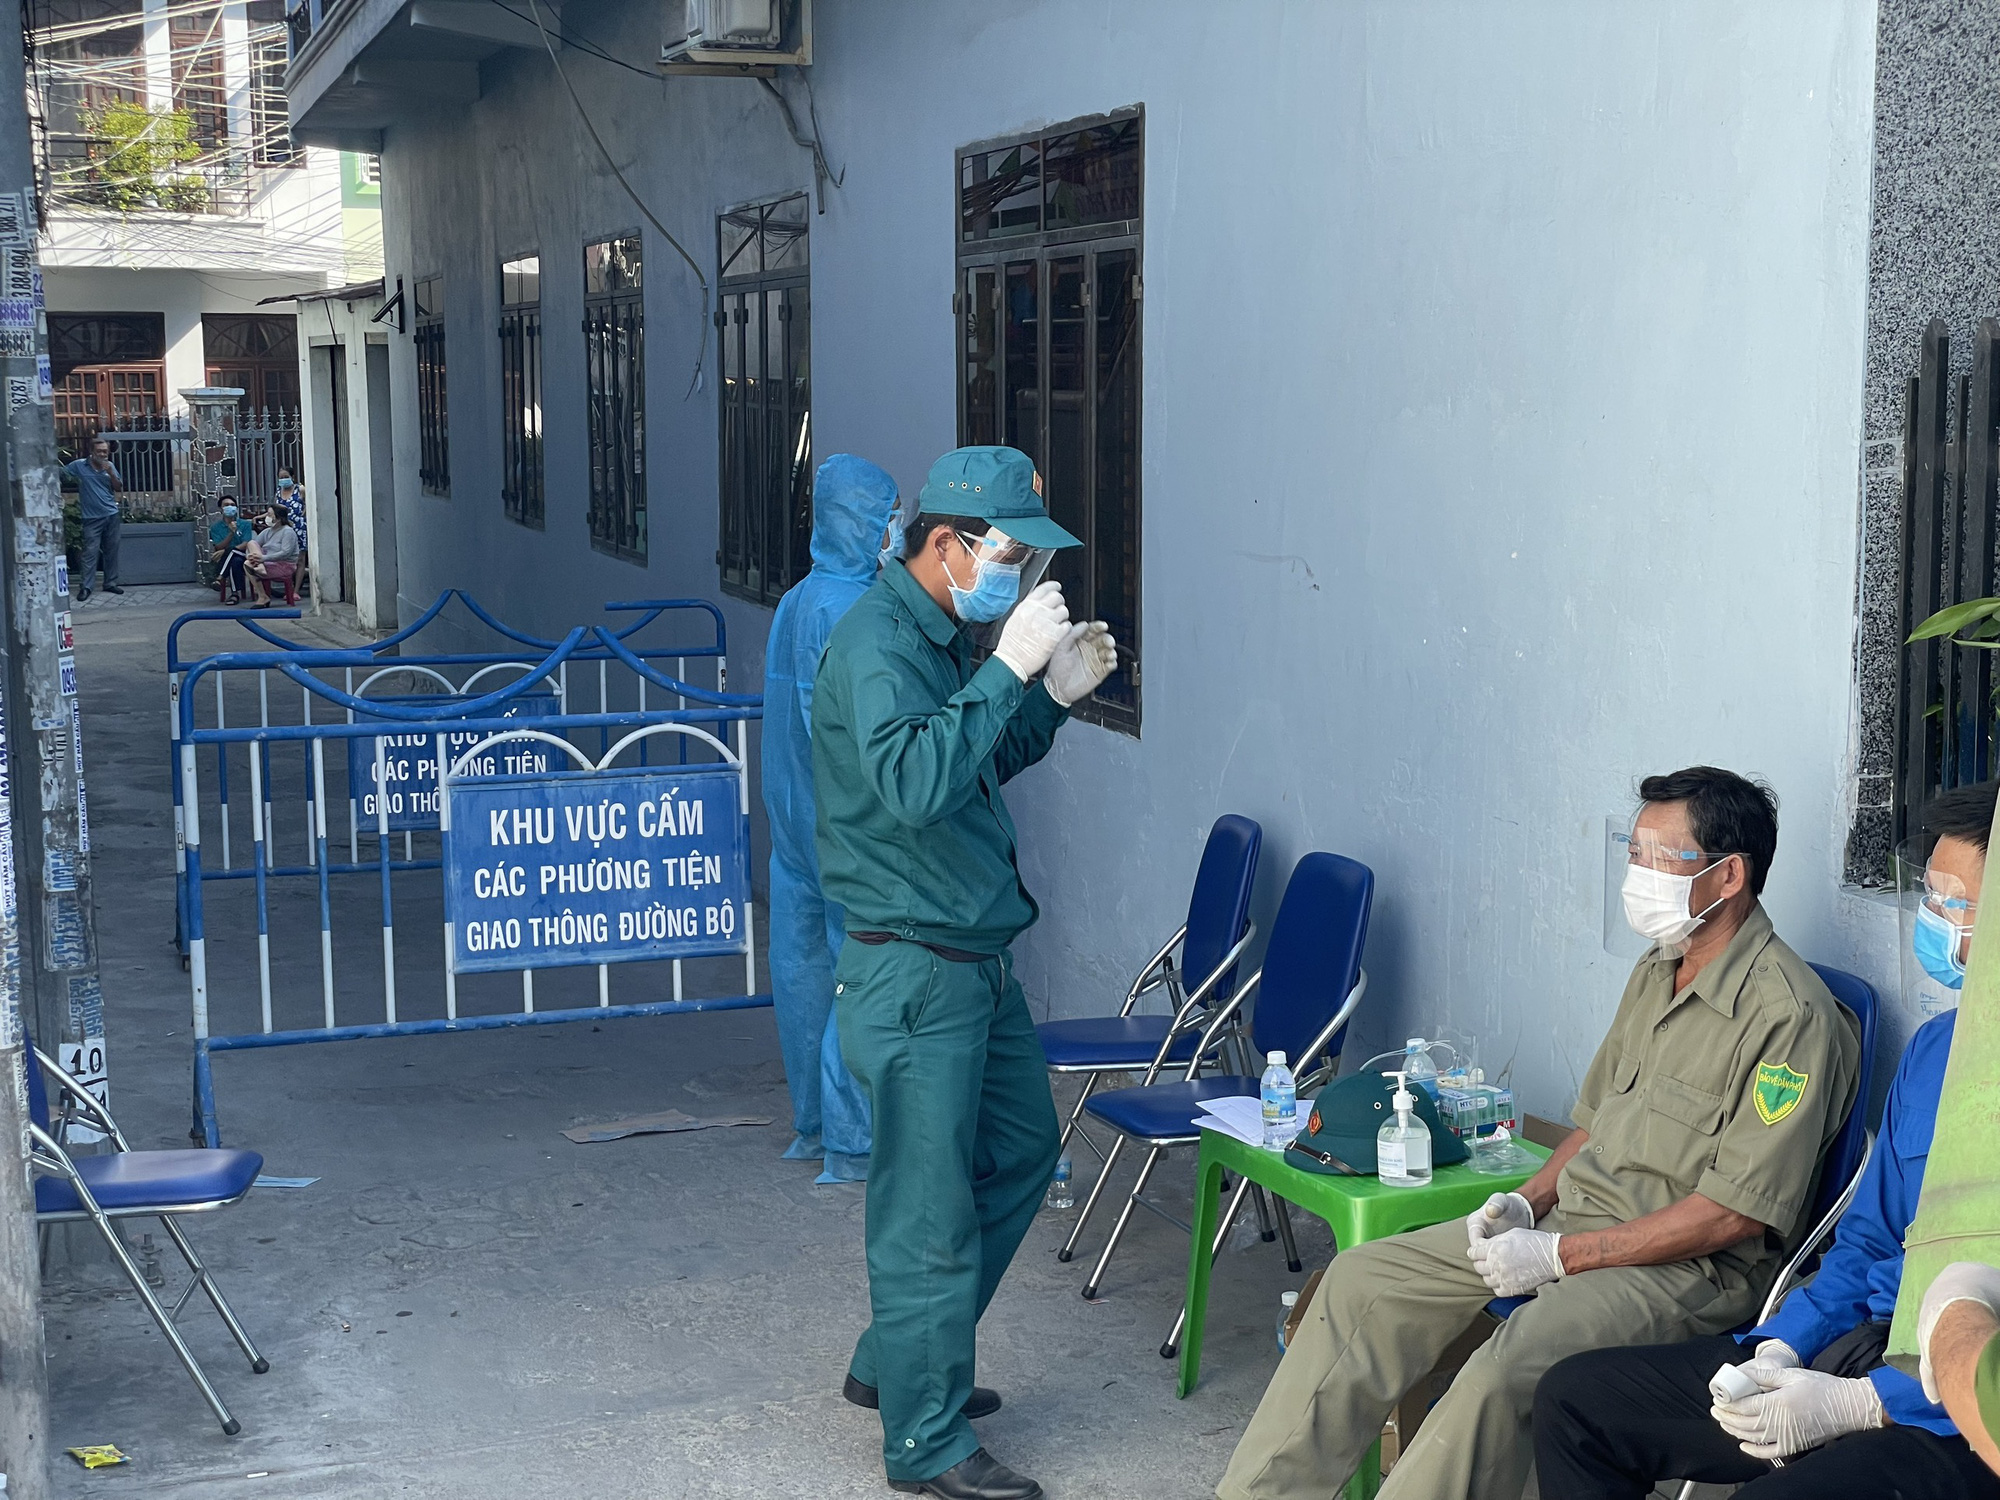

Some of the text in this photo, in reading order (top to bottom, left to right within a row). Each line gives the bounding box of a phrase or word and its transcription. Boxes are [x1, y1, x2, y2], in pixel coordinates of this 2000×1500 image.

[490, 787, 704, 848] KHU VỰC CẤM
[474, 850, 722, 898] CÁC PHƯƠNG TIỆN
[466, 898, 735, 952] GIAO THÔNG ĐƯỜNG BỘ
